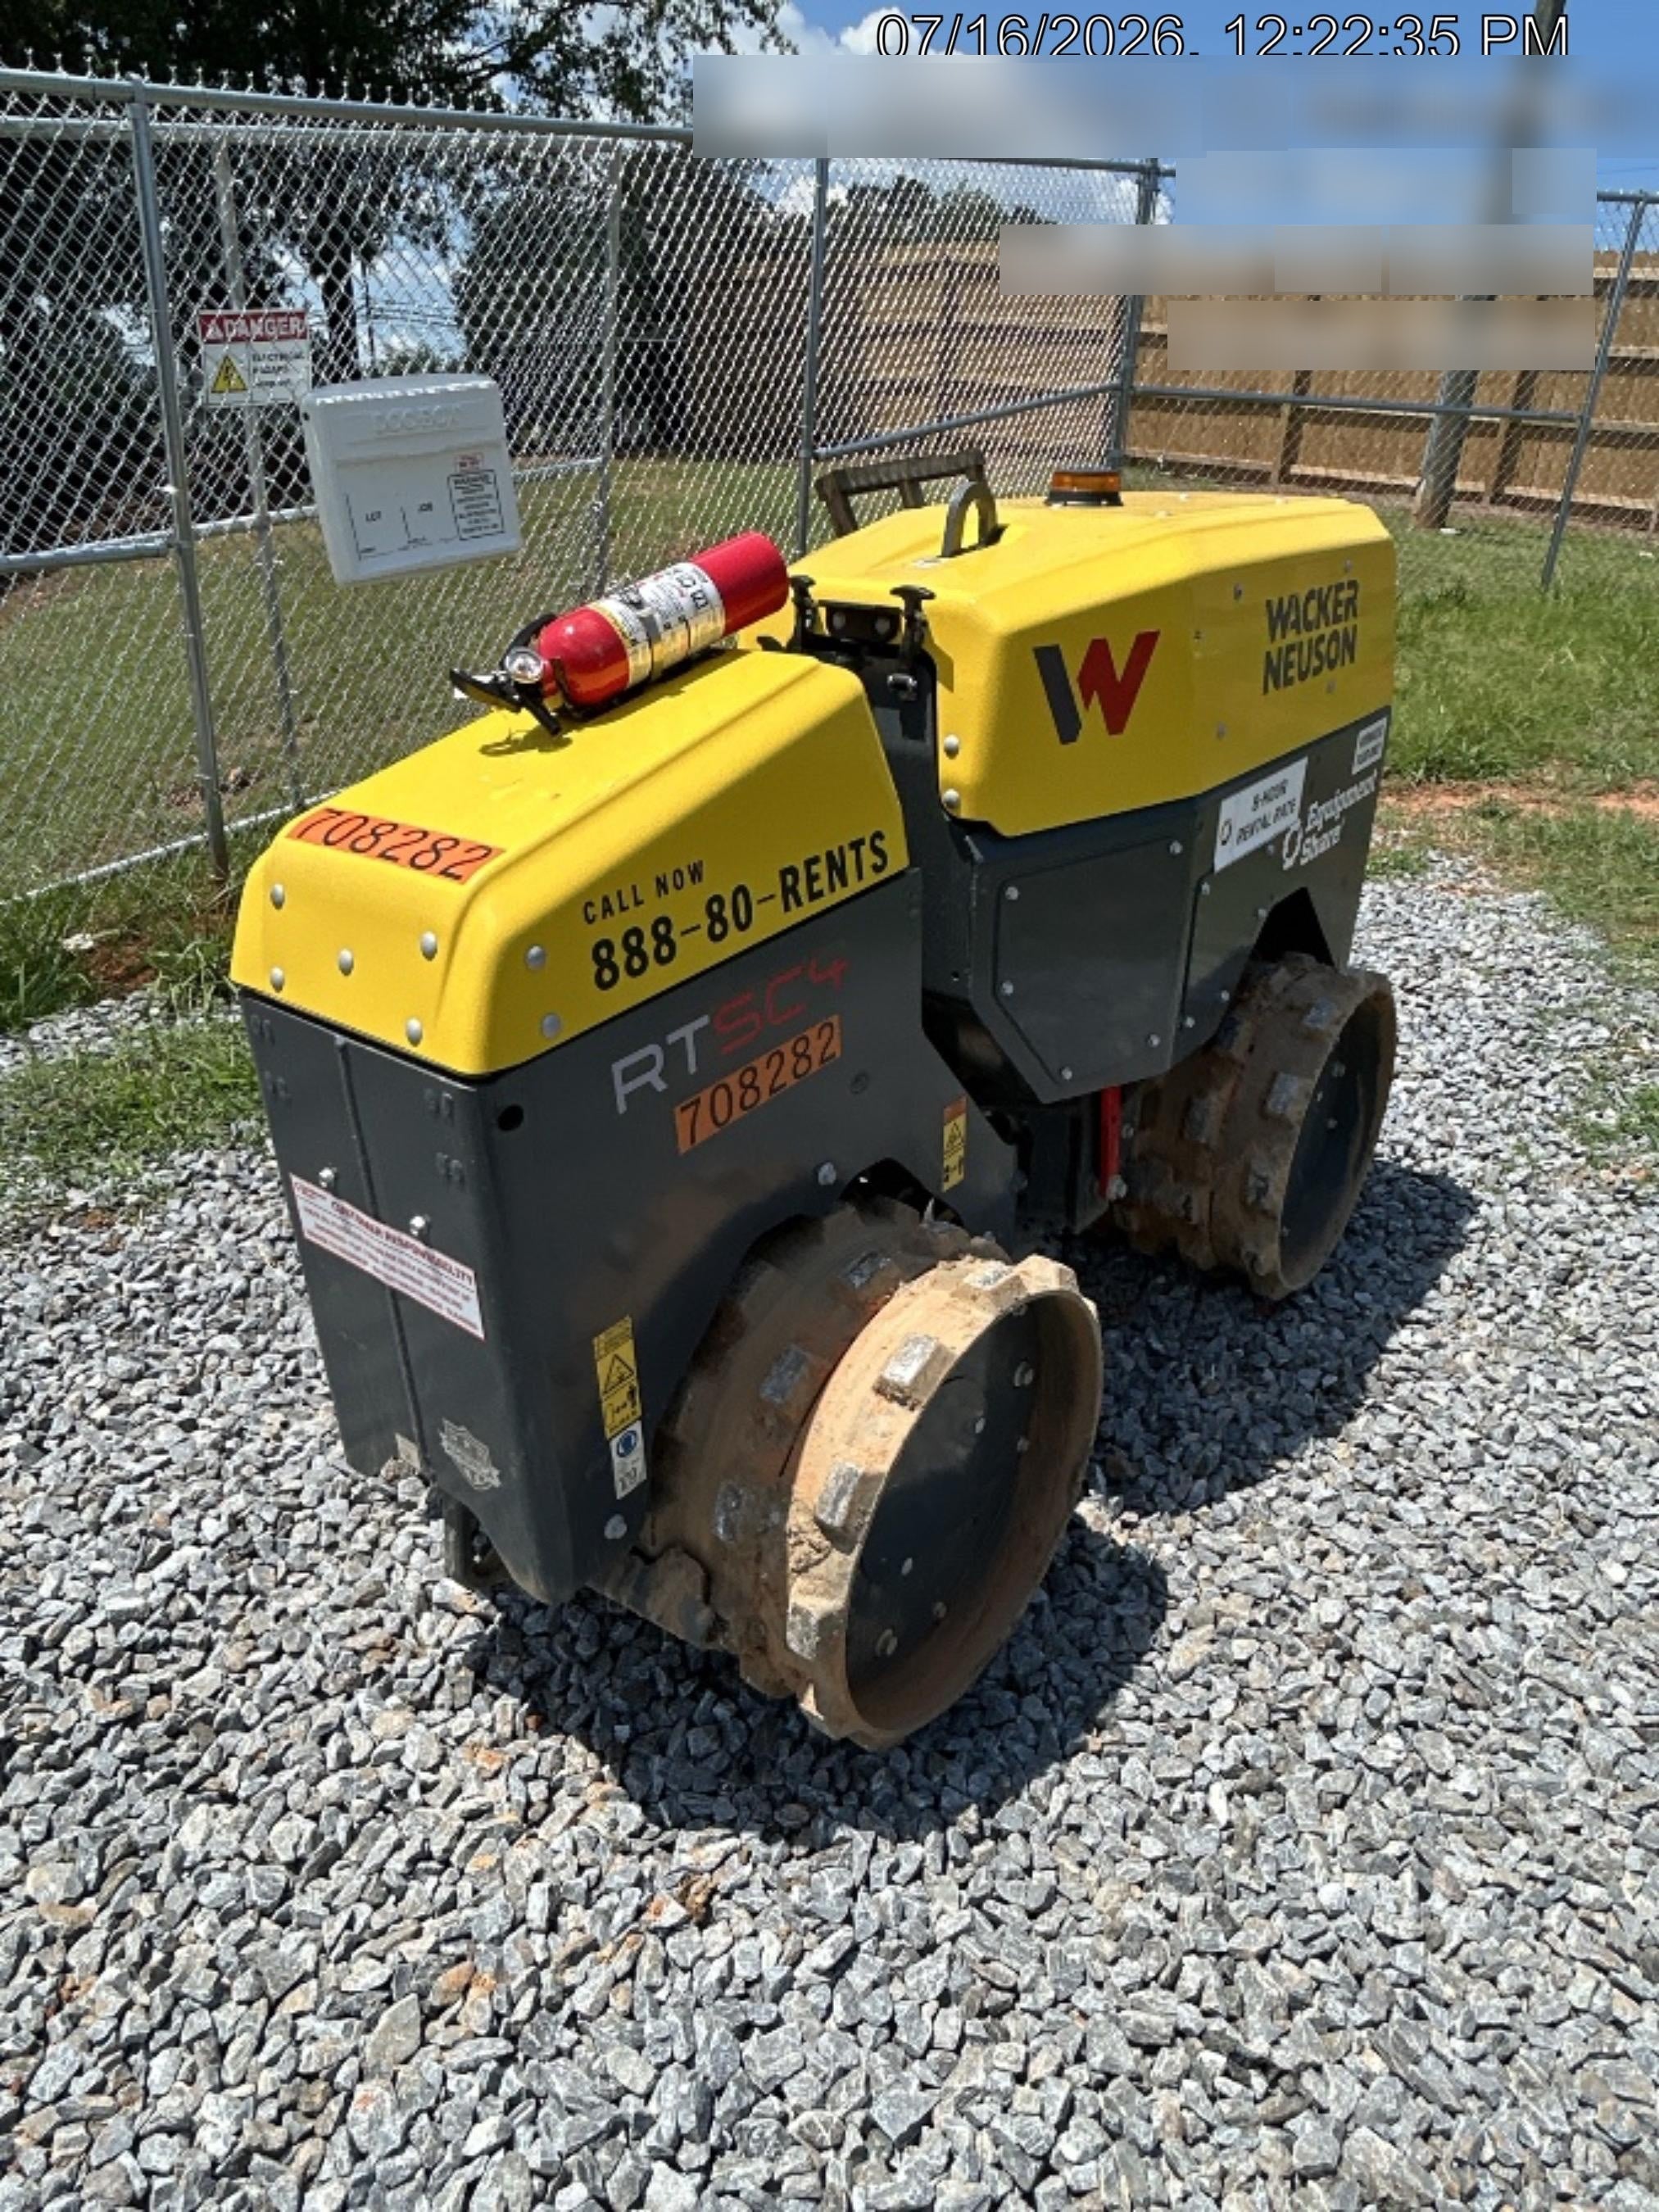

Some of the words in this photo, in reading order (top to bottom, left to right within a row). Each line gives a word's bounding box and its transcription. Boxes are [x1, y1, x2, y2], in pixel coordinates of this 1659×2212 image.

[224, 316, 306, 338] DANGER
[1266, 579, 1359, 644] WACKER
[1262, 624, 1358, 696] NEUSON
[297, 808, 492, 880] 708282
[582, 884, 645, 925] CALL
[655, 859, 705, 899] NOW
[592, 830, 889, 990] 888-80-RENTS
[680, 1022, 836, 1147] 708282
